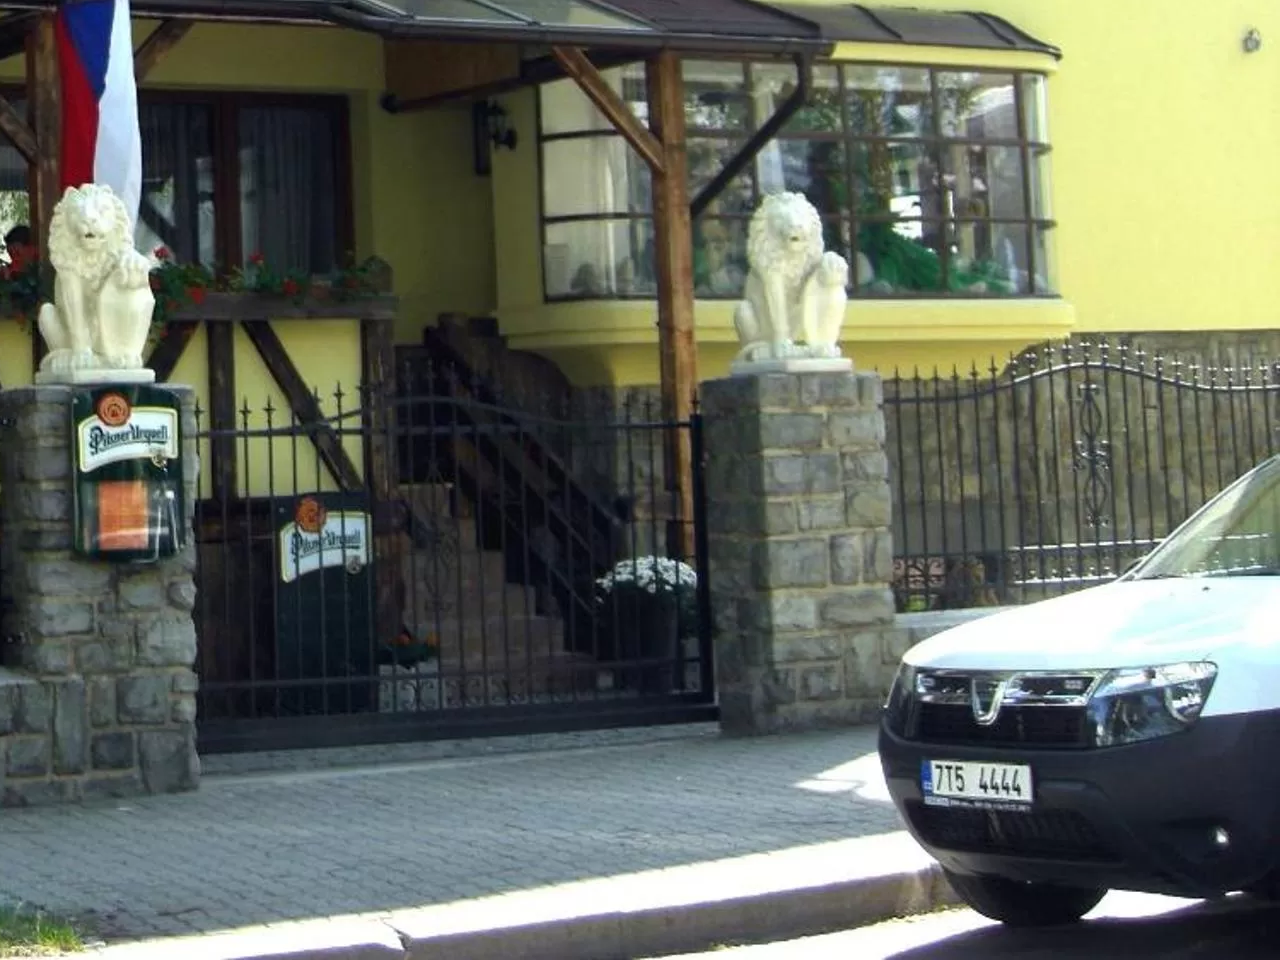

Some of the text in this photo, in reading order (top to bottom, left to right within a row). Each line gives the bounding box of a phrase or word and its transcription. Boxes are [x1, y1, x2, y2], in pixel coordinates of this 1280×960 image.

[89, 425, 129, 456] Pilsner
[291, 532, 325, 563] Pilsnr
[934, 764, 1022, 796] 7T5 4444
